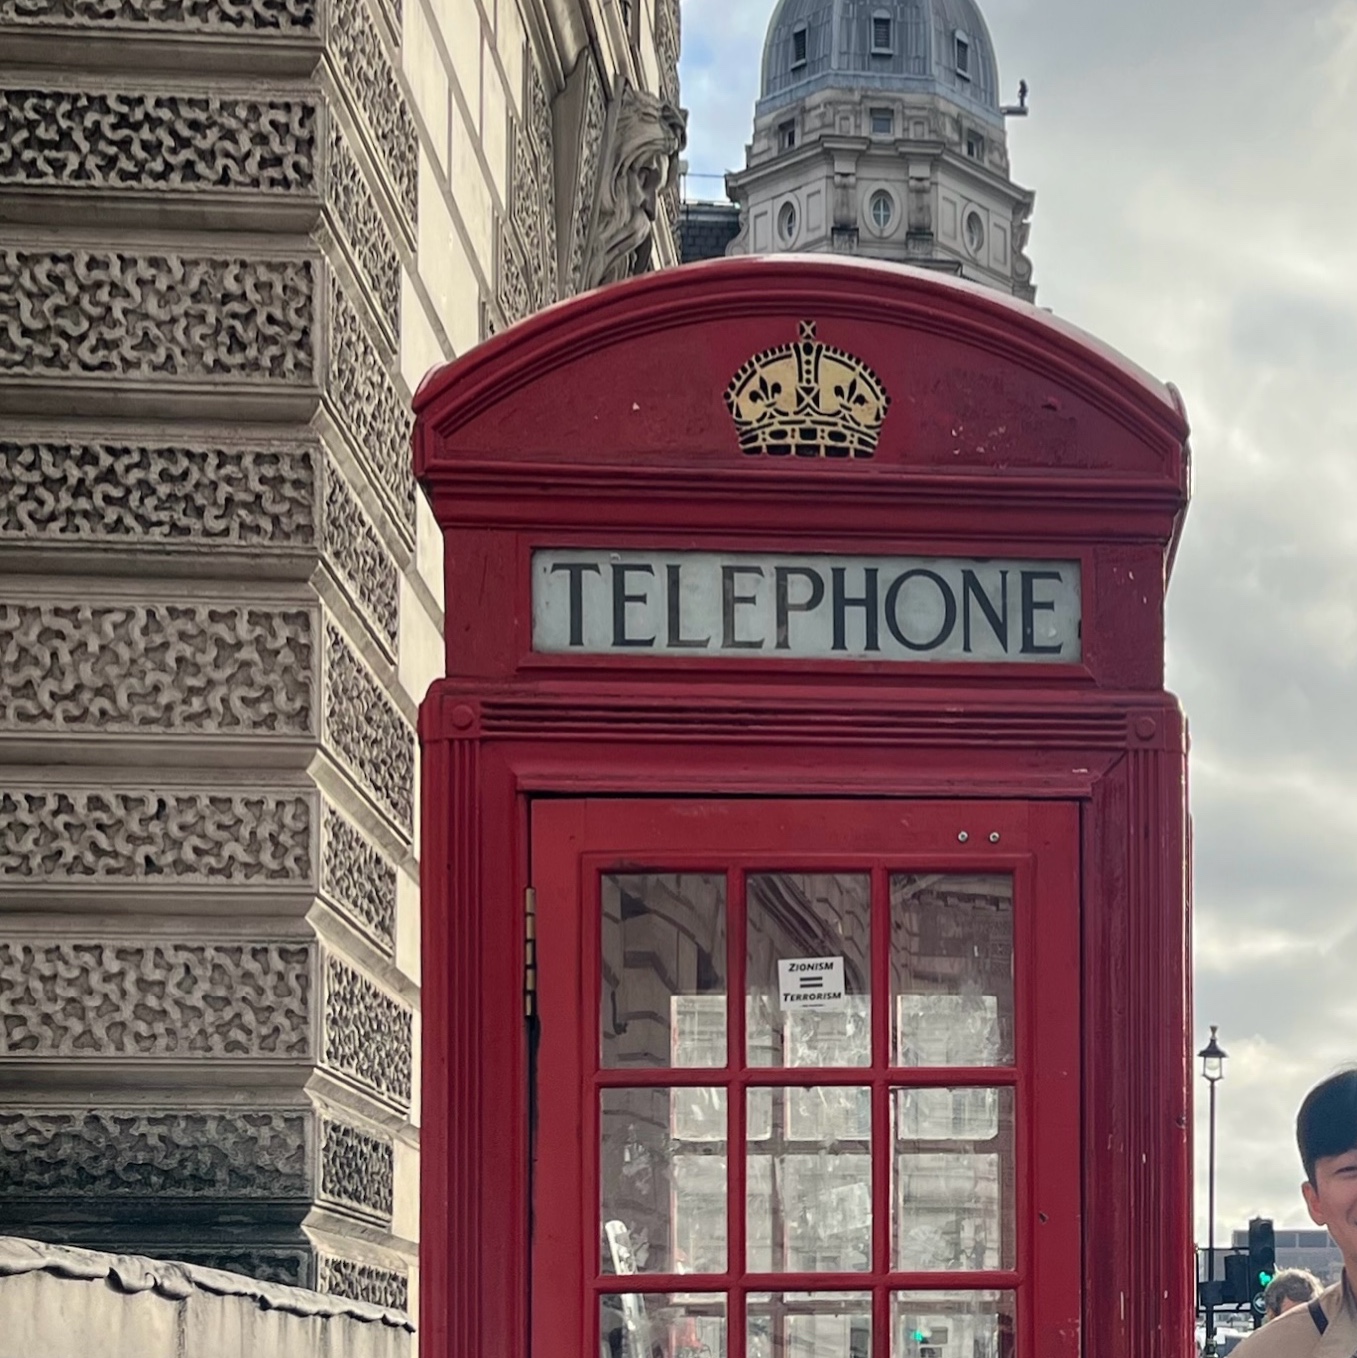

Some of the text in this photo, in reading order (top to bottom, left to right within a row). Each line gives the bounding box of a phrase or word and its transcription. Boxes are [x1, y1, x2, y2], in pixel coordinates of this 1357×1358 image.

[550, 562, 1064, 655] TELEPHONE
[788, 962, 834, 973] ZIONISM
[783, 991, 842, 1002] TERRORISM
